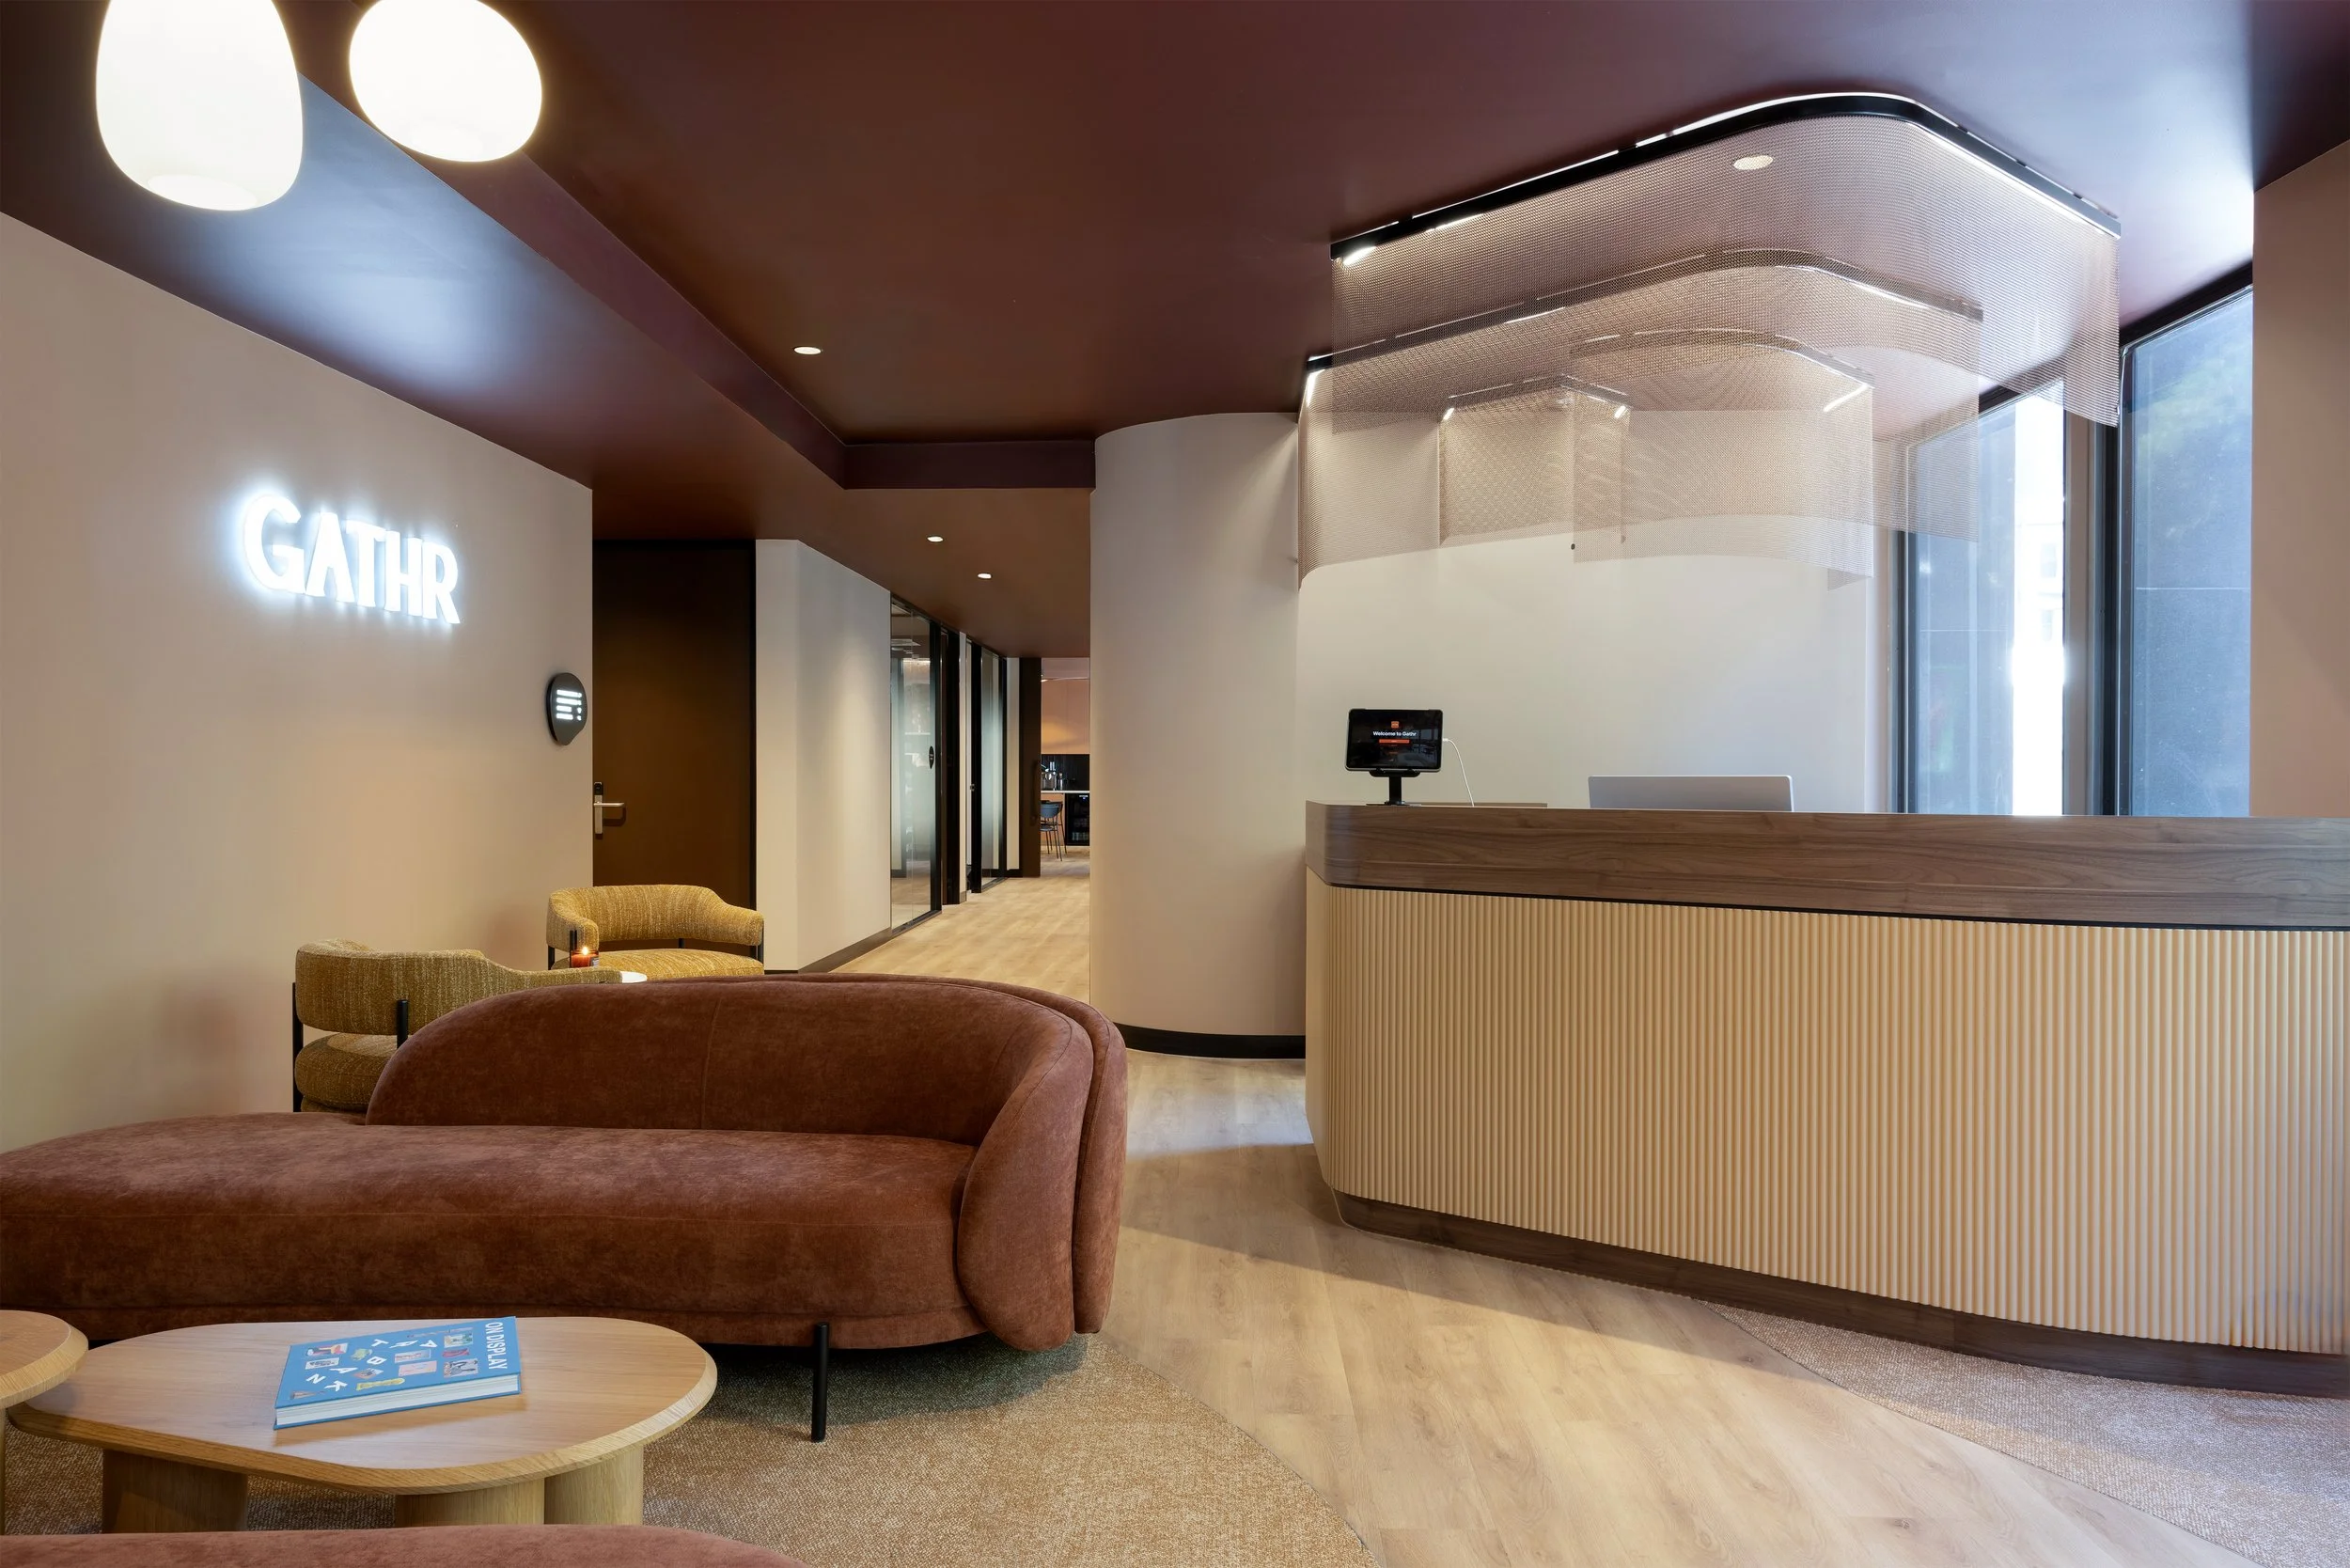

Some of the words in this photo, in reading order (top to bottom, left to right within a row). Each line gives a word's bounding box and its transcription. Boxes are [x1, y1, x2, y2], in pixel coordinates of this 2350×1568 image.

[243, 494, 461, 624] GATHR
[485, 1322, 504, 1334] ON
[486, 1334, 508, 1370] DISPLAY
